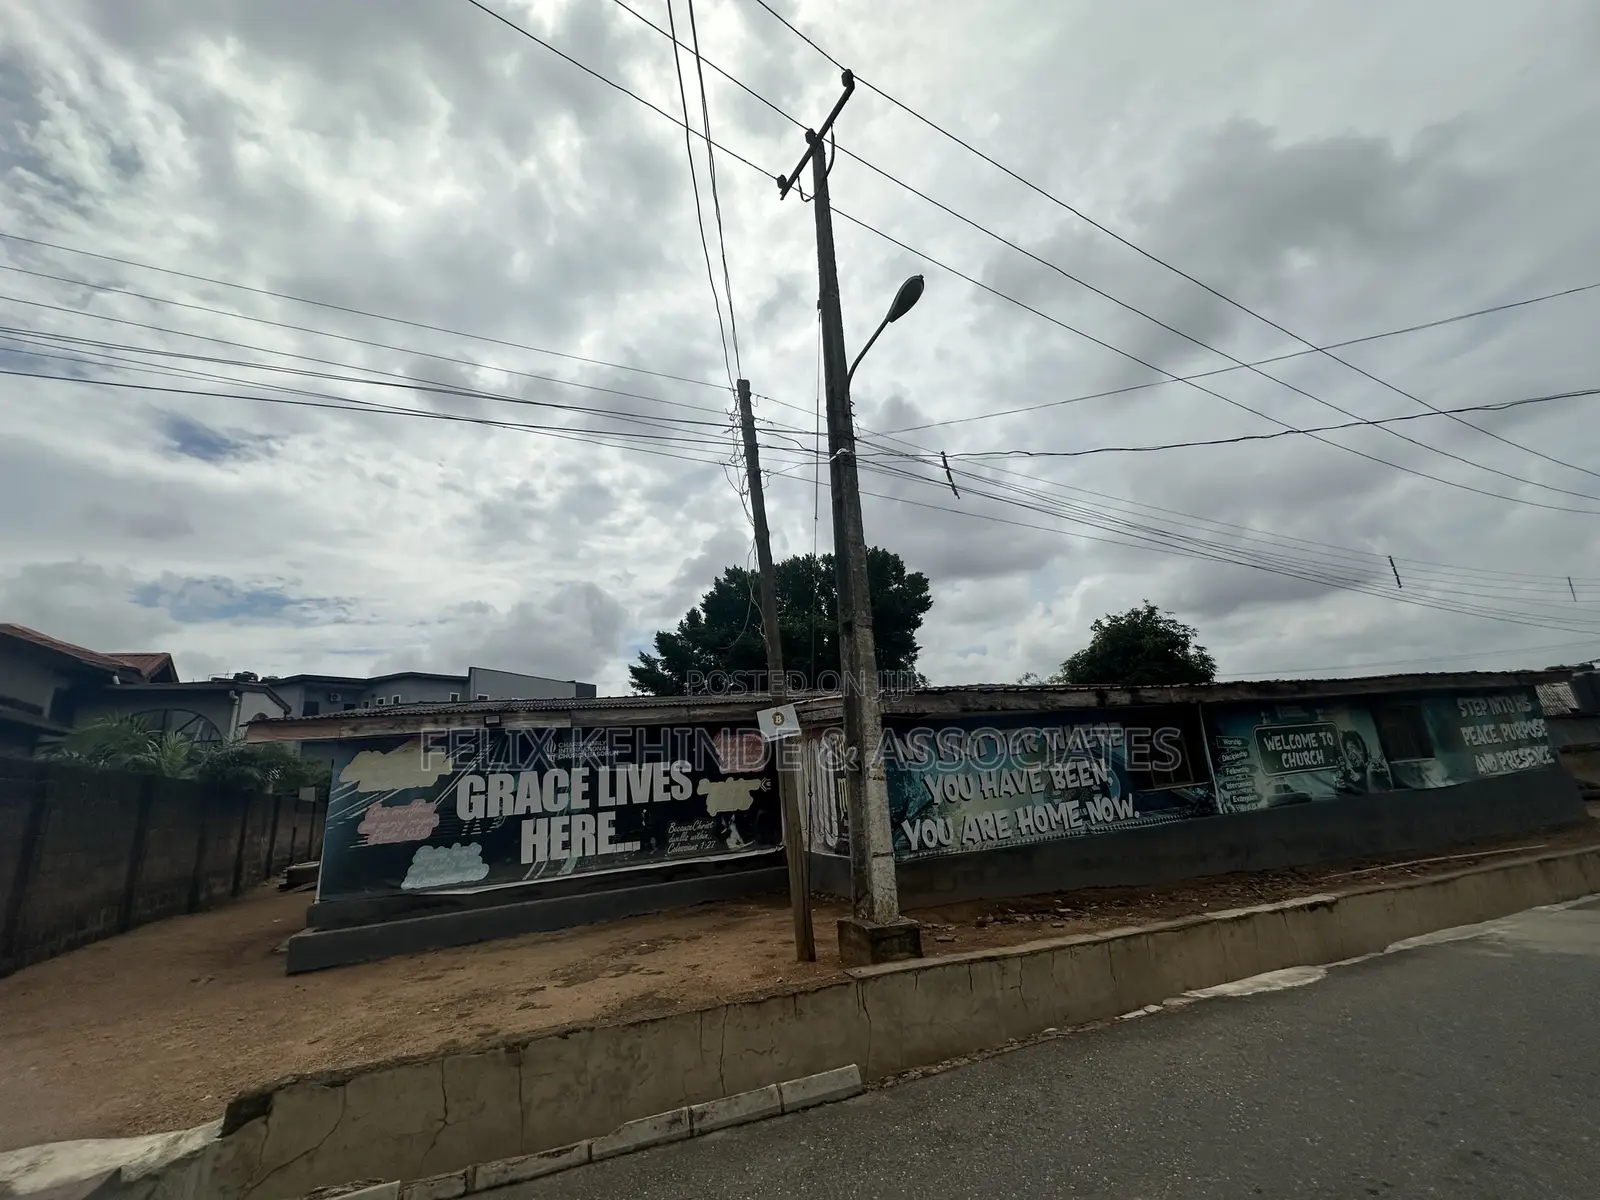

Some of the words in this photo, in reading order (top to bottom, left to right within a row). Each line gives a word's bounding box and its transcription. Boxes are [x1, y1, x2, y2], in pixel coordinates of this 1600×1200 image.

[1457, 696, 1488, 717] STEP
[1487, 695, 1515, 715] INTO
[1512, 694, 1532, 712] HIS
[1263, 732, 1319, 752] WELCOME
[1318, 731, 1334, 746] TO
[1500, 718, 1548, 742] PURPOSE
[1281, 749, 1325, 769] CHURCH
[1474, 752, 1498, 774] AND
[1496, 745, 1555, 771] PRESENCE
[456, 767, 590, 821] GRACE
[597, 759, 693, 808] LIVES
[923, 770, 973, 805] YOU
[979, 767, 1046, 800] HAVE
[901, 816, 954, 851] YOU
[961, 809, 1014, 845] ARE
[1016, 799, 1085, 837] HOME
[1086, 793, 1140, 825] NOW.
[520, 811, 641, 865] HERE...
[700, 840, 717, 851] 1:27
